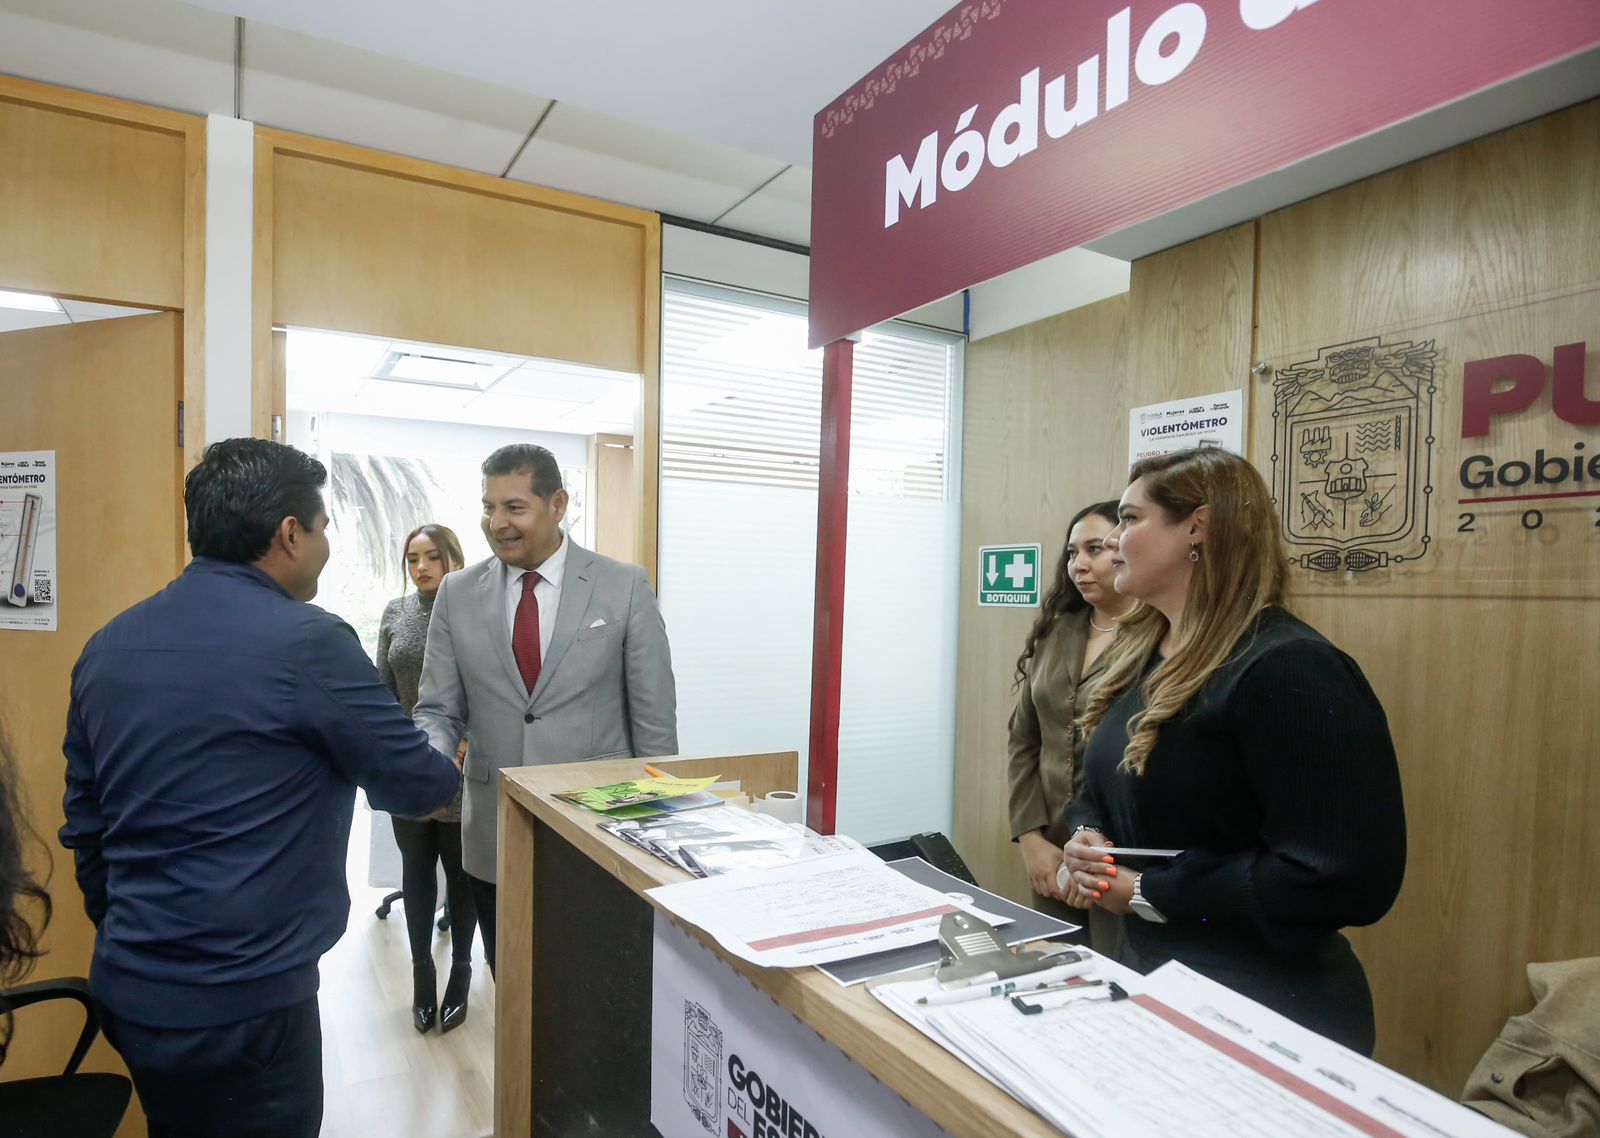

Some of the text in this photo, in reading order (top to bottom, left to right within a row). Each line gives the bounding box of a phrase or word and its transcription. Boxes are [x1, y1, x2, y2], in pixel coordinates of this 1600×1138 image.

[884, 2, 1207, 229] Módulo
[1461, 341, 1600, 439] PU
[1141, 417, 1228, 437] VIOLENTÓMETRO
[986, 593, 1030, 603] BOTIQUIN
[727, 1086, 751, 1127] DEL
